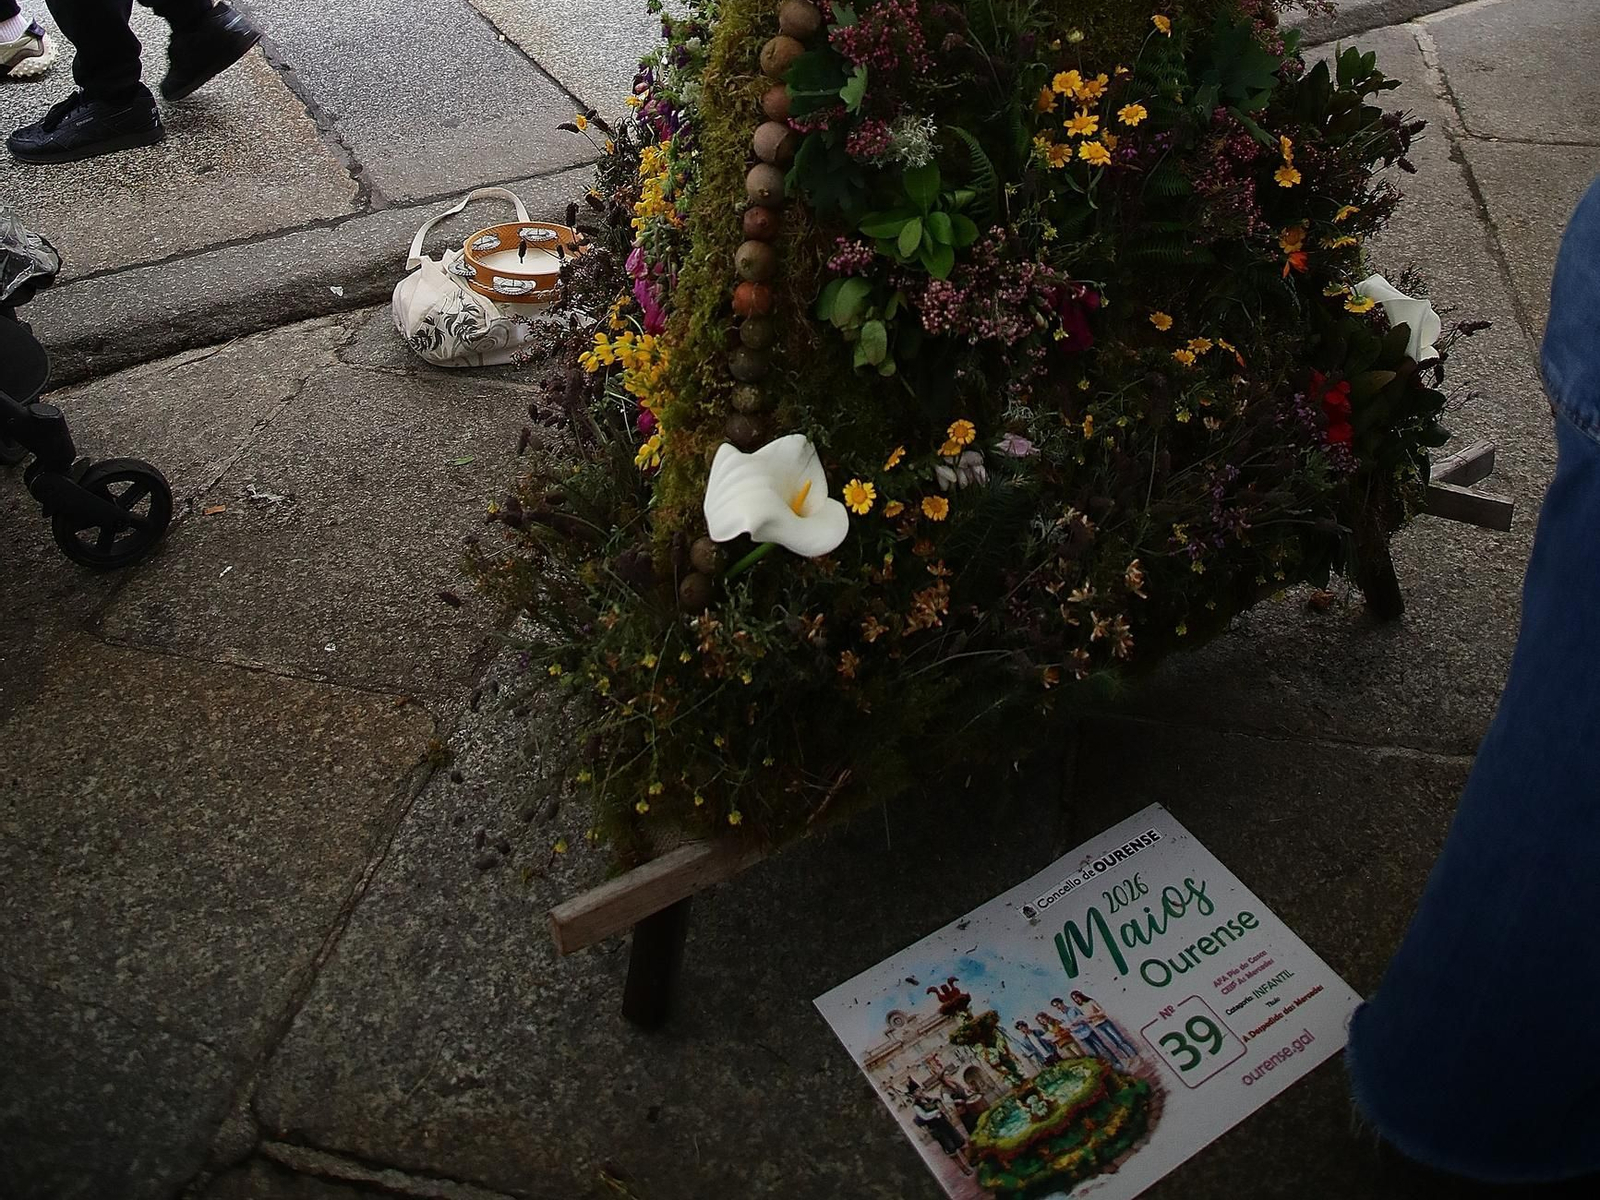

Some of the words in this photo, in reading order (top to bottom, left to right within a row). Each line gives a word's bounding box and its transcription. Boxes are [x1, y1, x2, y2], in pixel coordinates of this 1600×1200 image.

[1037, 878, 1081, 909] Concello
[1082, 868, 1096, 881] de
[1093, 829, 1161, 873] OURENSE
[1102, 872, 1150, 914] 2026
[1054, 876, 1216, 979] Maios
[1140, 910, 1260, 988] Ourense
[1245, 958, 1274, 979] Mercedes
[1252, 969, 1295, 999] INFANTIL
[1243, 1035, 1250, 1043] A
[1248, 1012, 1284, 1038] Despedida
[1283, 1004, 1296, 1016] das
[1293, 984, 1324, 1007] Mercedes
[1159, 1015, 1223, 1072] 39
[1242, 1028, 1315, 1086] ourense.gal
